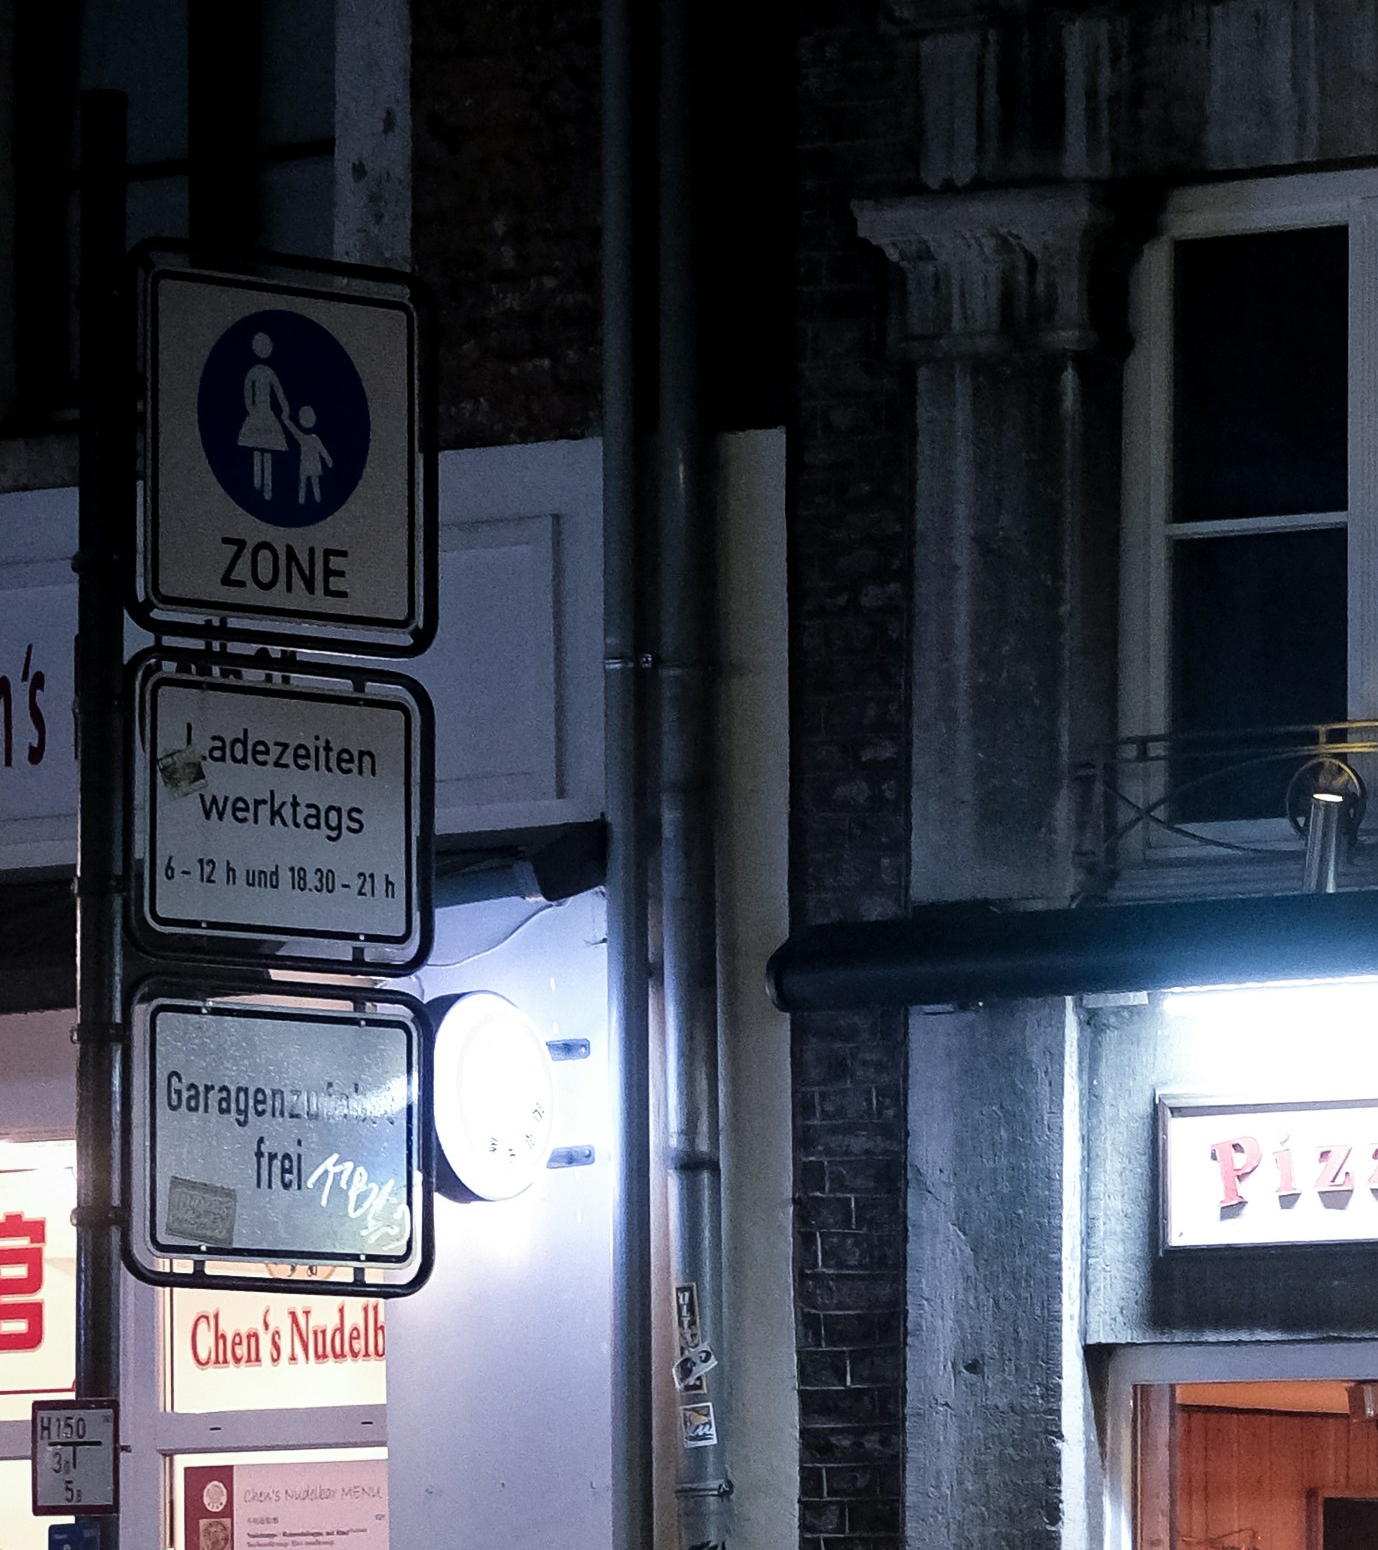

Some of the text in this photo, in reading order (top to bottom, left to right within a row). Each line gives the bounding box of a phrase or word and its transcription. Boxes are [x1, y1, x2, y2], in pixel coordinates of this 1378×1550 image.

[219, 536, 350, 599] ZONE
[199, 789, 365, 843] werktags
[164, 855, 175, 881] 6
[198, 858, 216, 886] 12
[226, 860, 236, 886] h
[246, 864, 279, 890] und
[289, 865, 335, 893] 18.30
[357, 872, 375, 898] 21
[384, 876, 396, 899] h
[254, 1136, 302, 1192] frei
[341, 1485, 384, 1500] MENU
